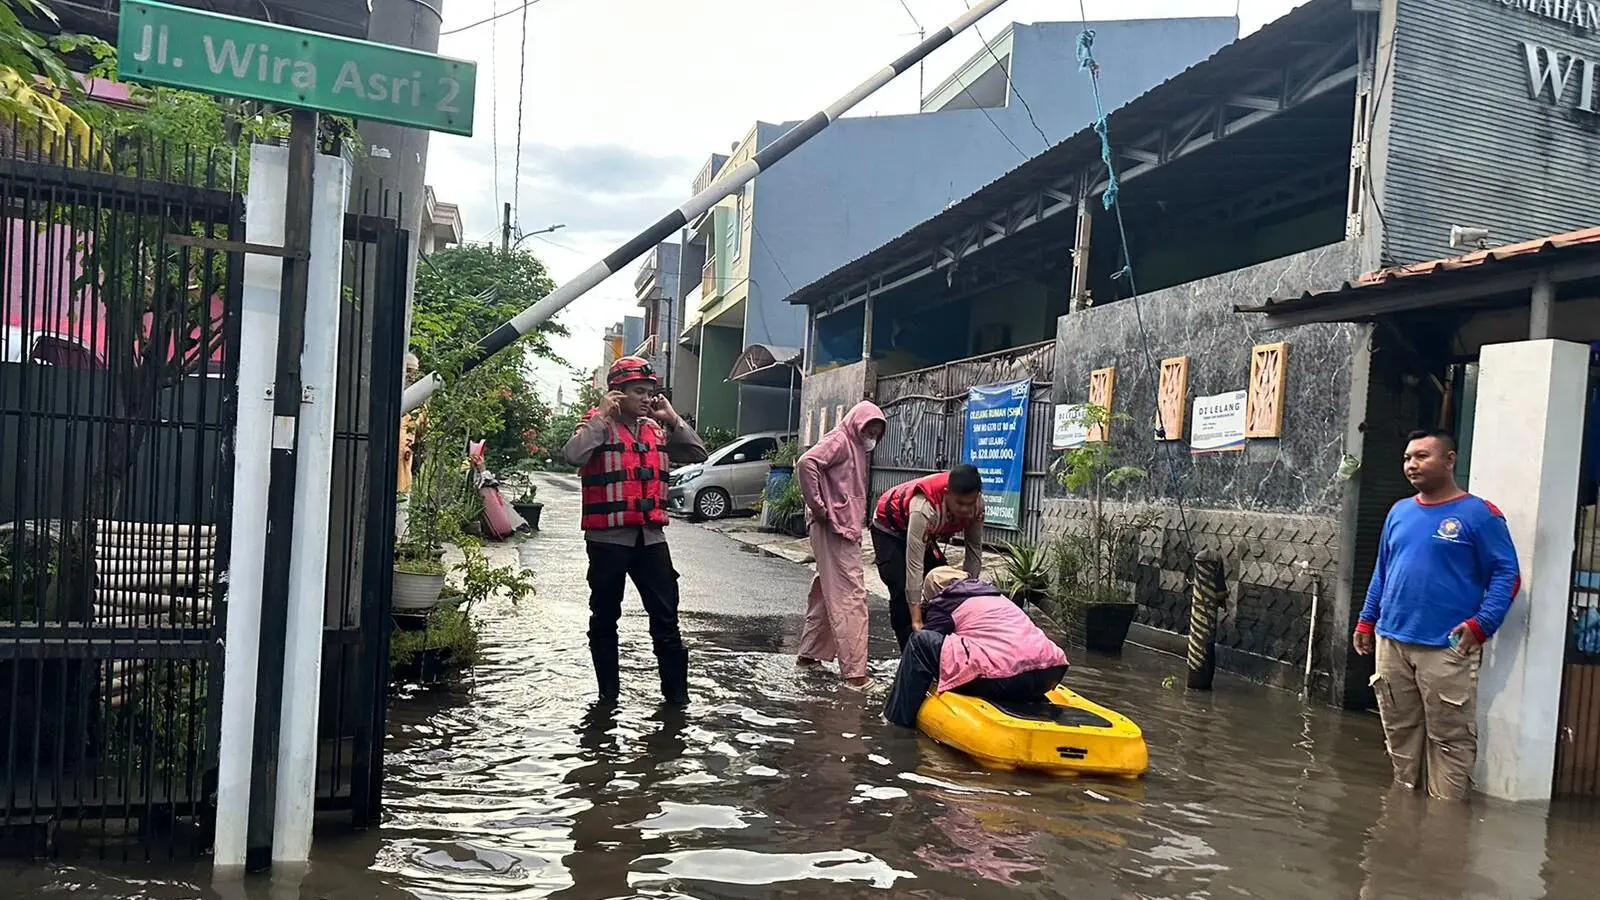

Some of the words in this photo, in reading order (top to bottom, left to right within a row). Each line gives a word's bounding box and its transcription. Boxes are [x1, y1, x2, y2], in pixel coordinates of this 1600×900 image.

[133, 24, 184, 68] Jl.
[202, 34, 317, 89] Wira
[332, 60, 421, 107] Asri
[437, 76, 461, 113] 2
[1521, 41, 1600, 114] WI
[1209, 402, 1240, 414] LELANG
